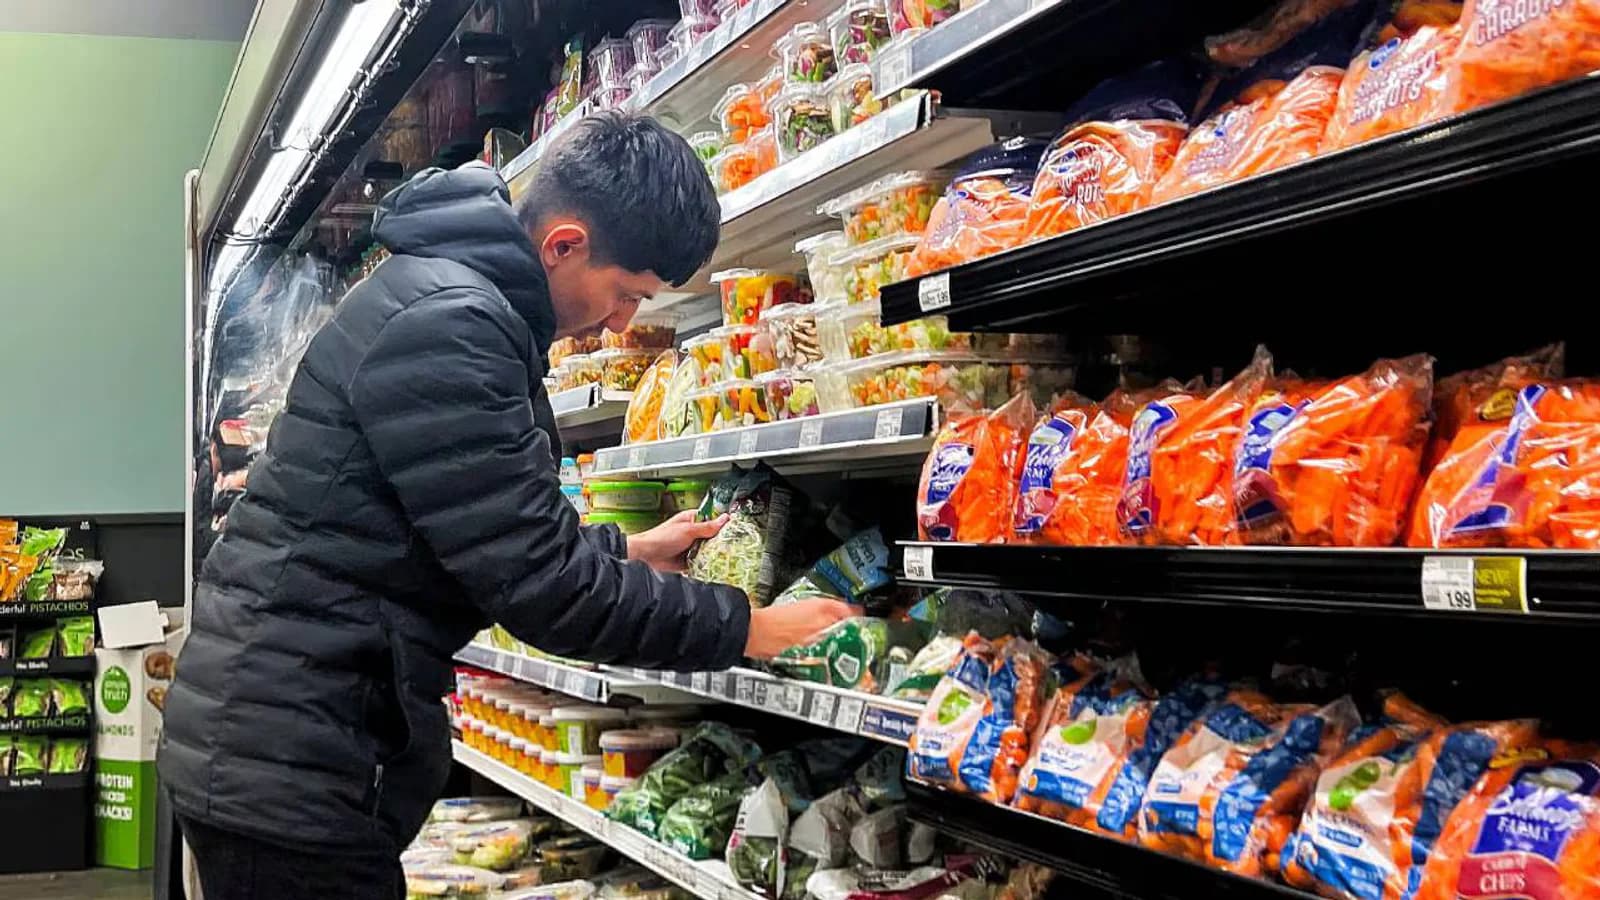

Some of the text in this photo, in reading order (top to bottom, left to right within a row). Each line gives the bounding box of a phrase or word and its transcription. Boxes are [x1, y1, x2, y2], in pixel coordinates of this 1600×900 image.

[29, 601, 89, 614] PISTACHIOS
[1446, 591, 1472, 609] 1.99
[26, 717, 87, 729] PISTACHIOS
[1479, 872, 1526, 893] CHIPS
